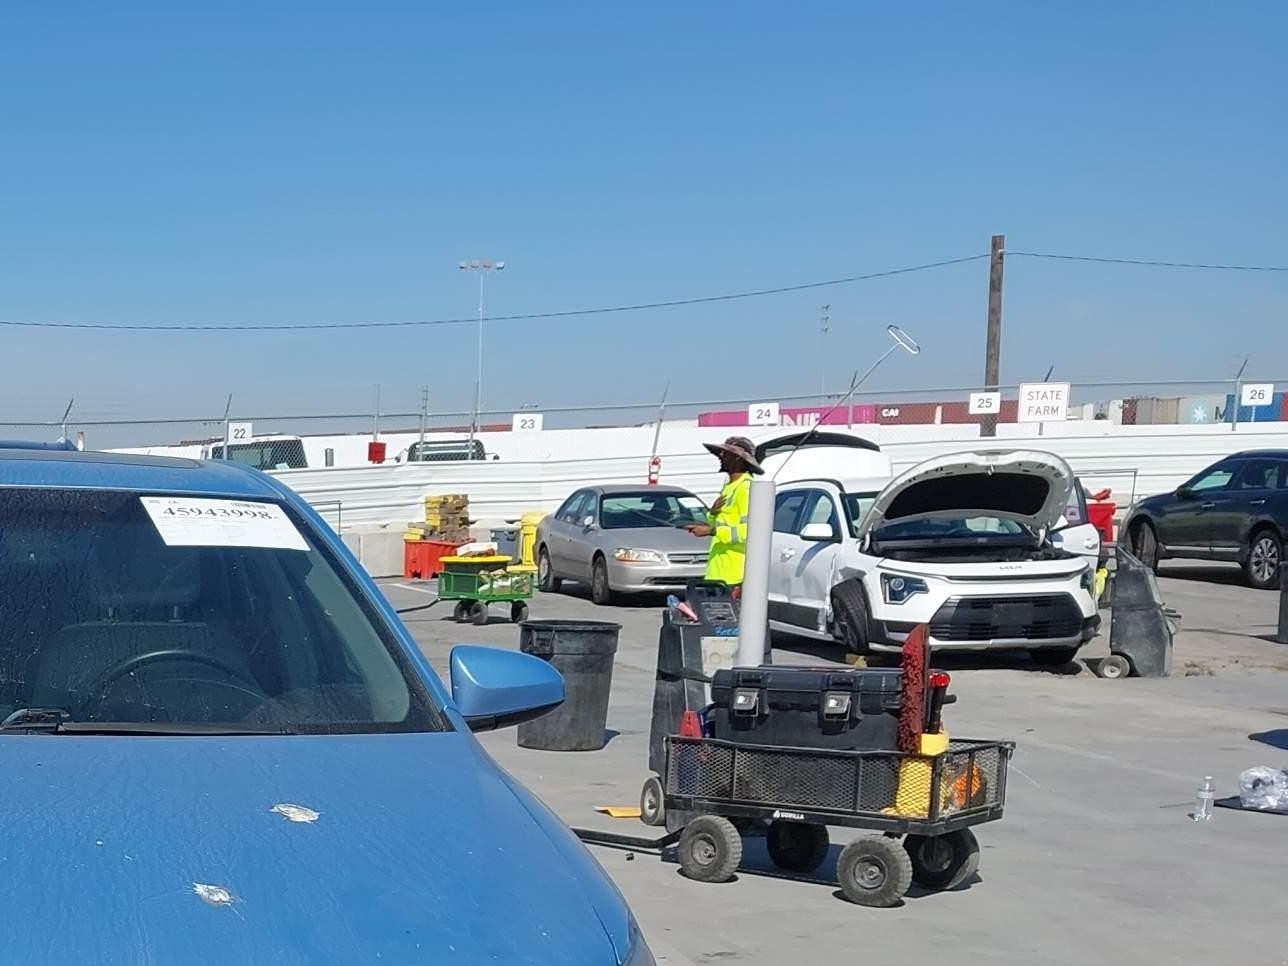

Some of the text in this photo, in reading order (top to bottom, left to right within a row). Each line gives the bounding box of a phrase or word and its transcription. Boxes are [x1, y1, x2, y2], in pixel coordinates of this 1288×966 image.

[1027, 390, 1063, 401] STATE
[1249, 389, 1265, 400] 26
[977, 398, 993, 409] 25
[756, 408, 771, 420] 24
[1027, 406, 1060, 417] FARM
[520, 418, 536, 430] 23
[233, 428, 246, 440] 22
[163, 506, 273, 520] 45943998
